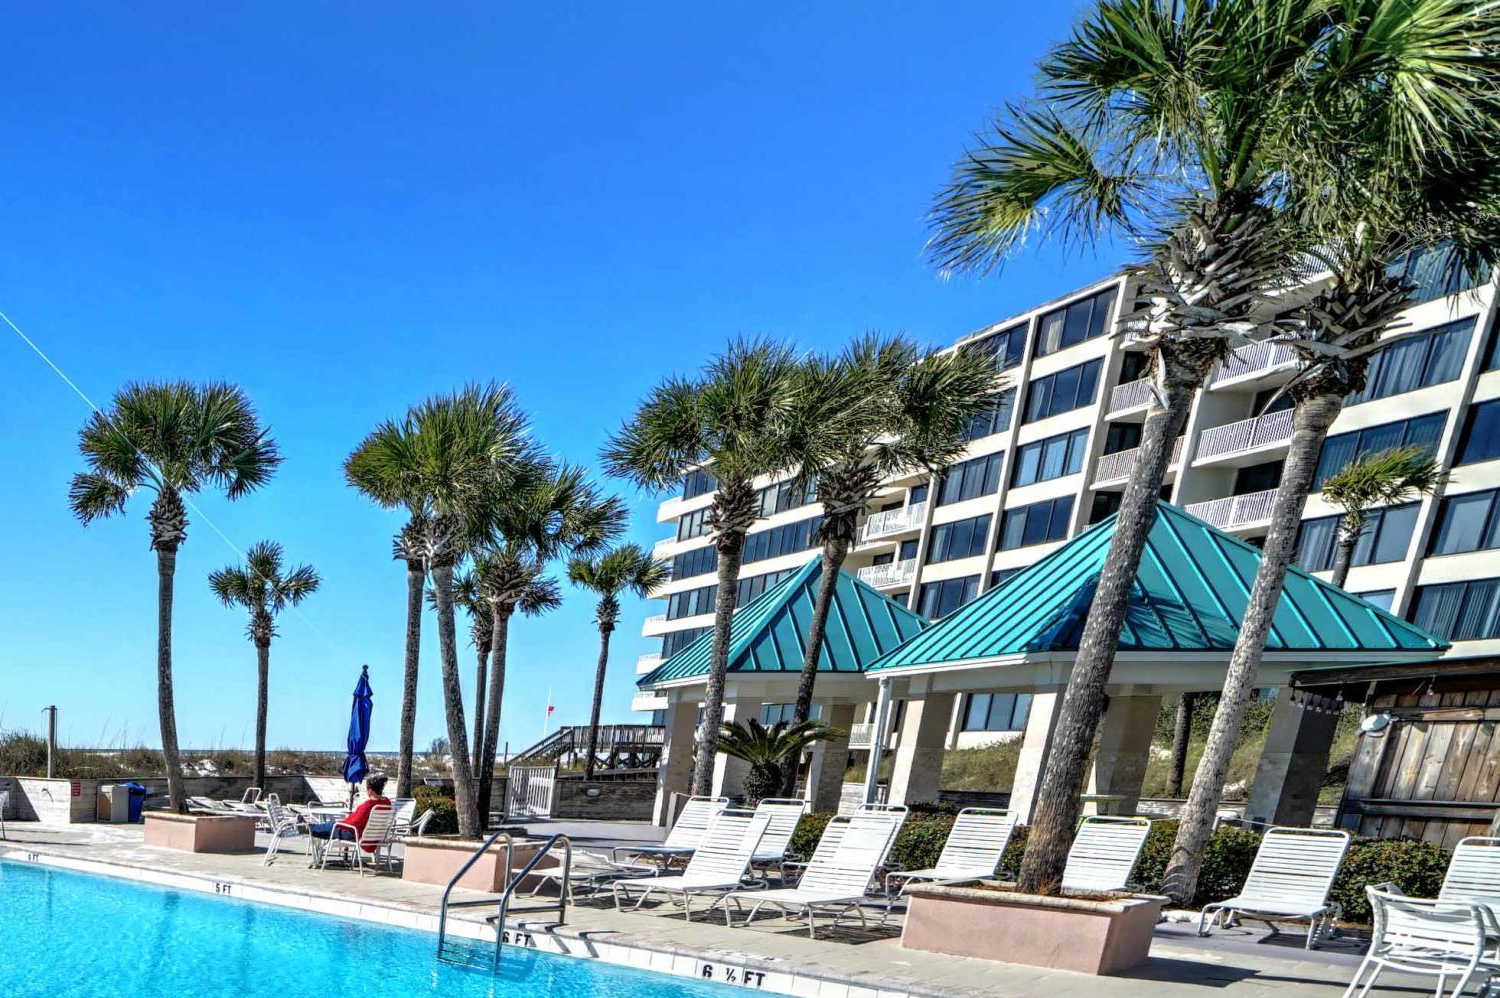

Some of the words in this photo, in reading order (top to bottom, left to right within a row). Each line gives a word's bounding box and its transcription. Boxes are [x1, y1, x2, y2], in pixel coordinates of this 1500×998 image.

[215, 883, 221, 893] 5
[223, 884, 231, 894] FT
[514, 933, 531, 946] FT
[702, 964, 713, 978] 6
[743, 971, 765, 987] FT
